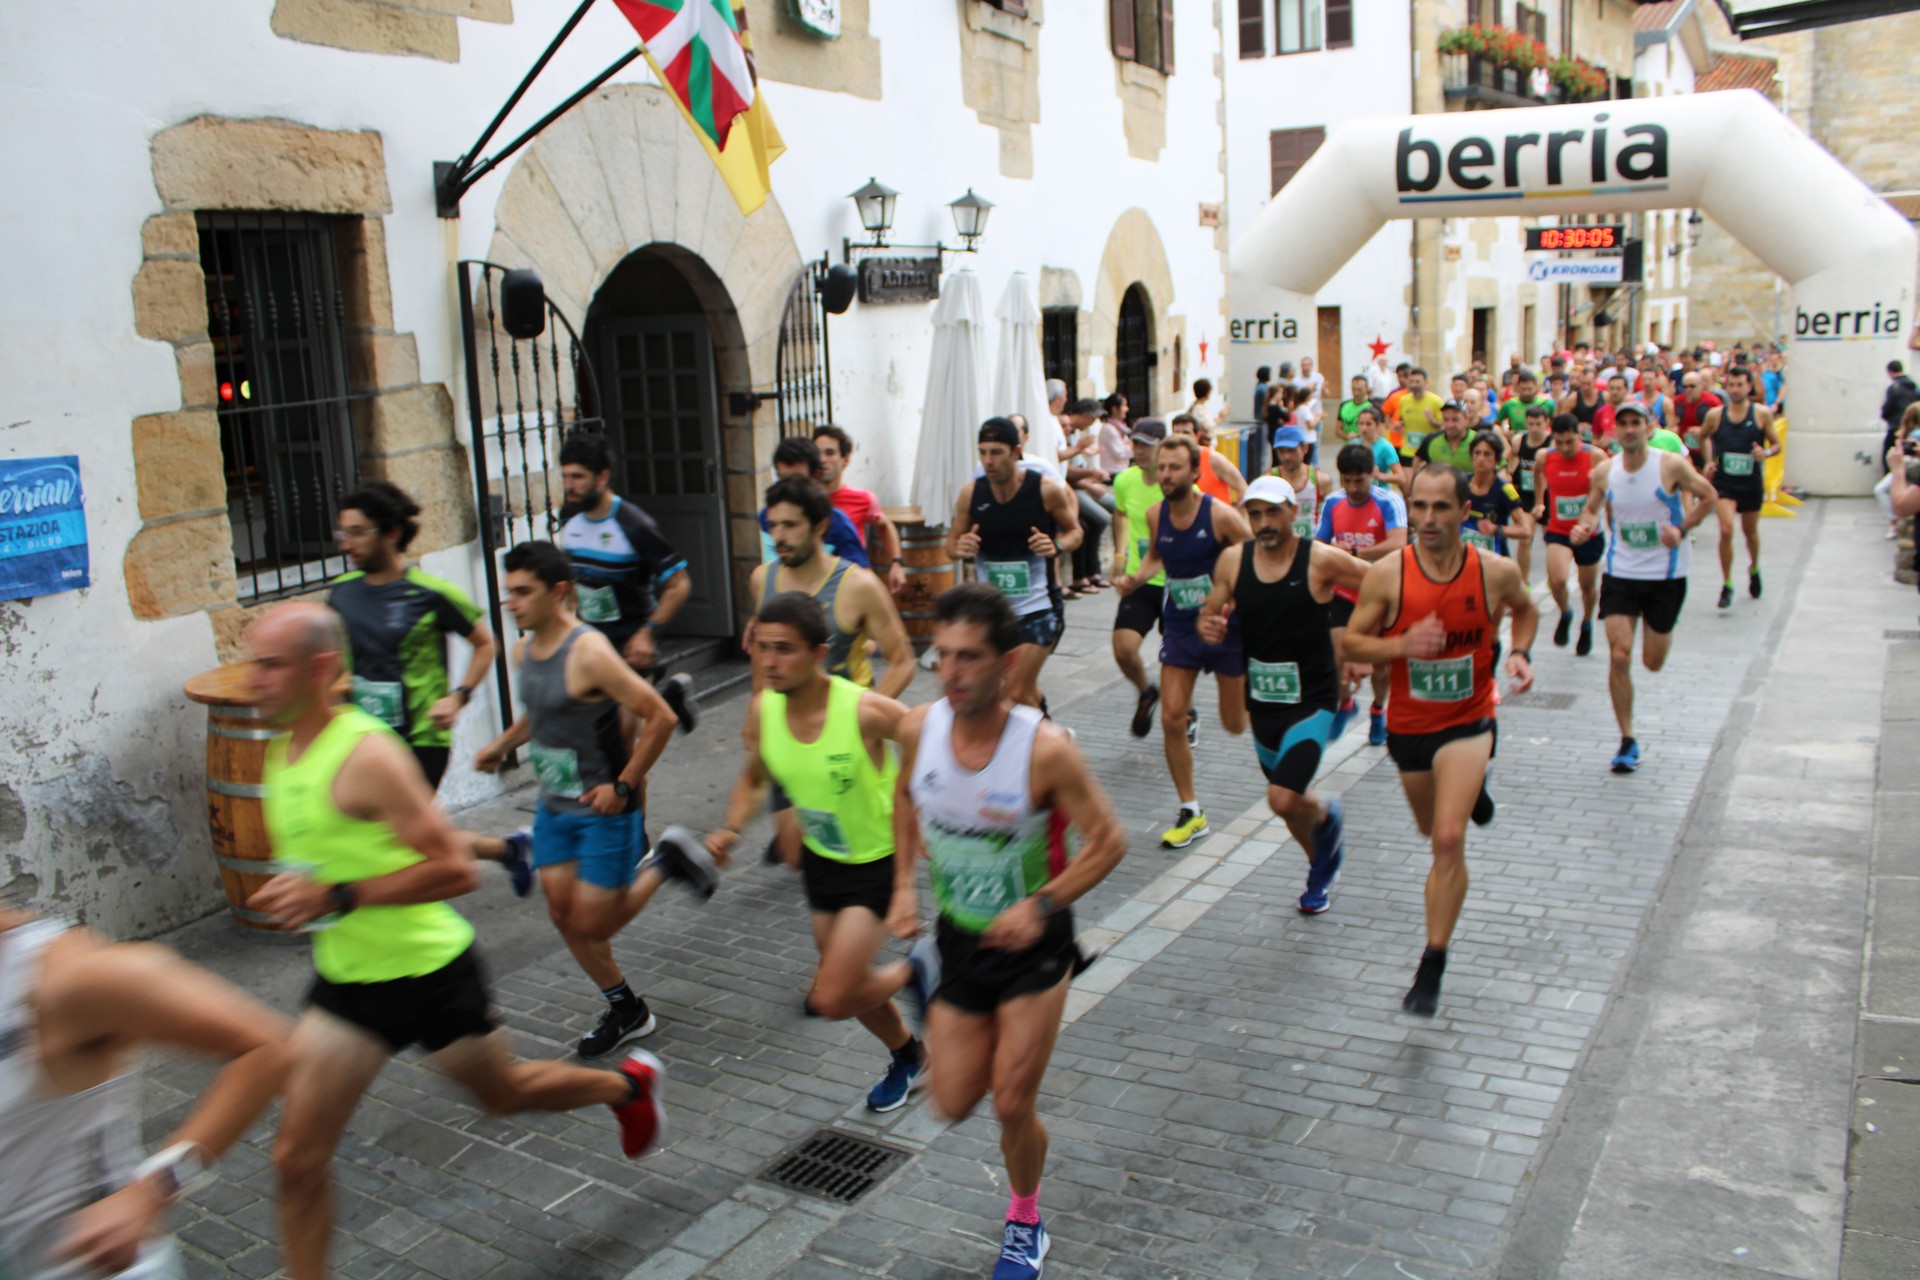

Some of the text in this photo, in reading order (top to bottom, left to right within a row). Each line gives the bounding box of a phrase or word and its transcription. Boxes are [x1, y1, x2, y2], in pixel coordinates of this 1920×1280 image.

[1396, 112, 1669, 192] berria
[1540, 228, 1615, 248] 10:30:05
[1229, 312, 1298, 338] erria
[1794, 302, 1900, 335] berria
[996, 573, 1016, 588] 79
[1256, 675, 1288, 692] 114
[1422, 674, 1458, 692] 111
